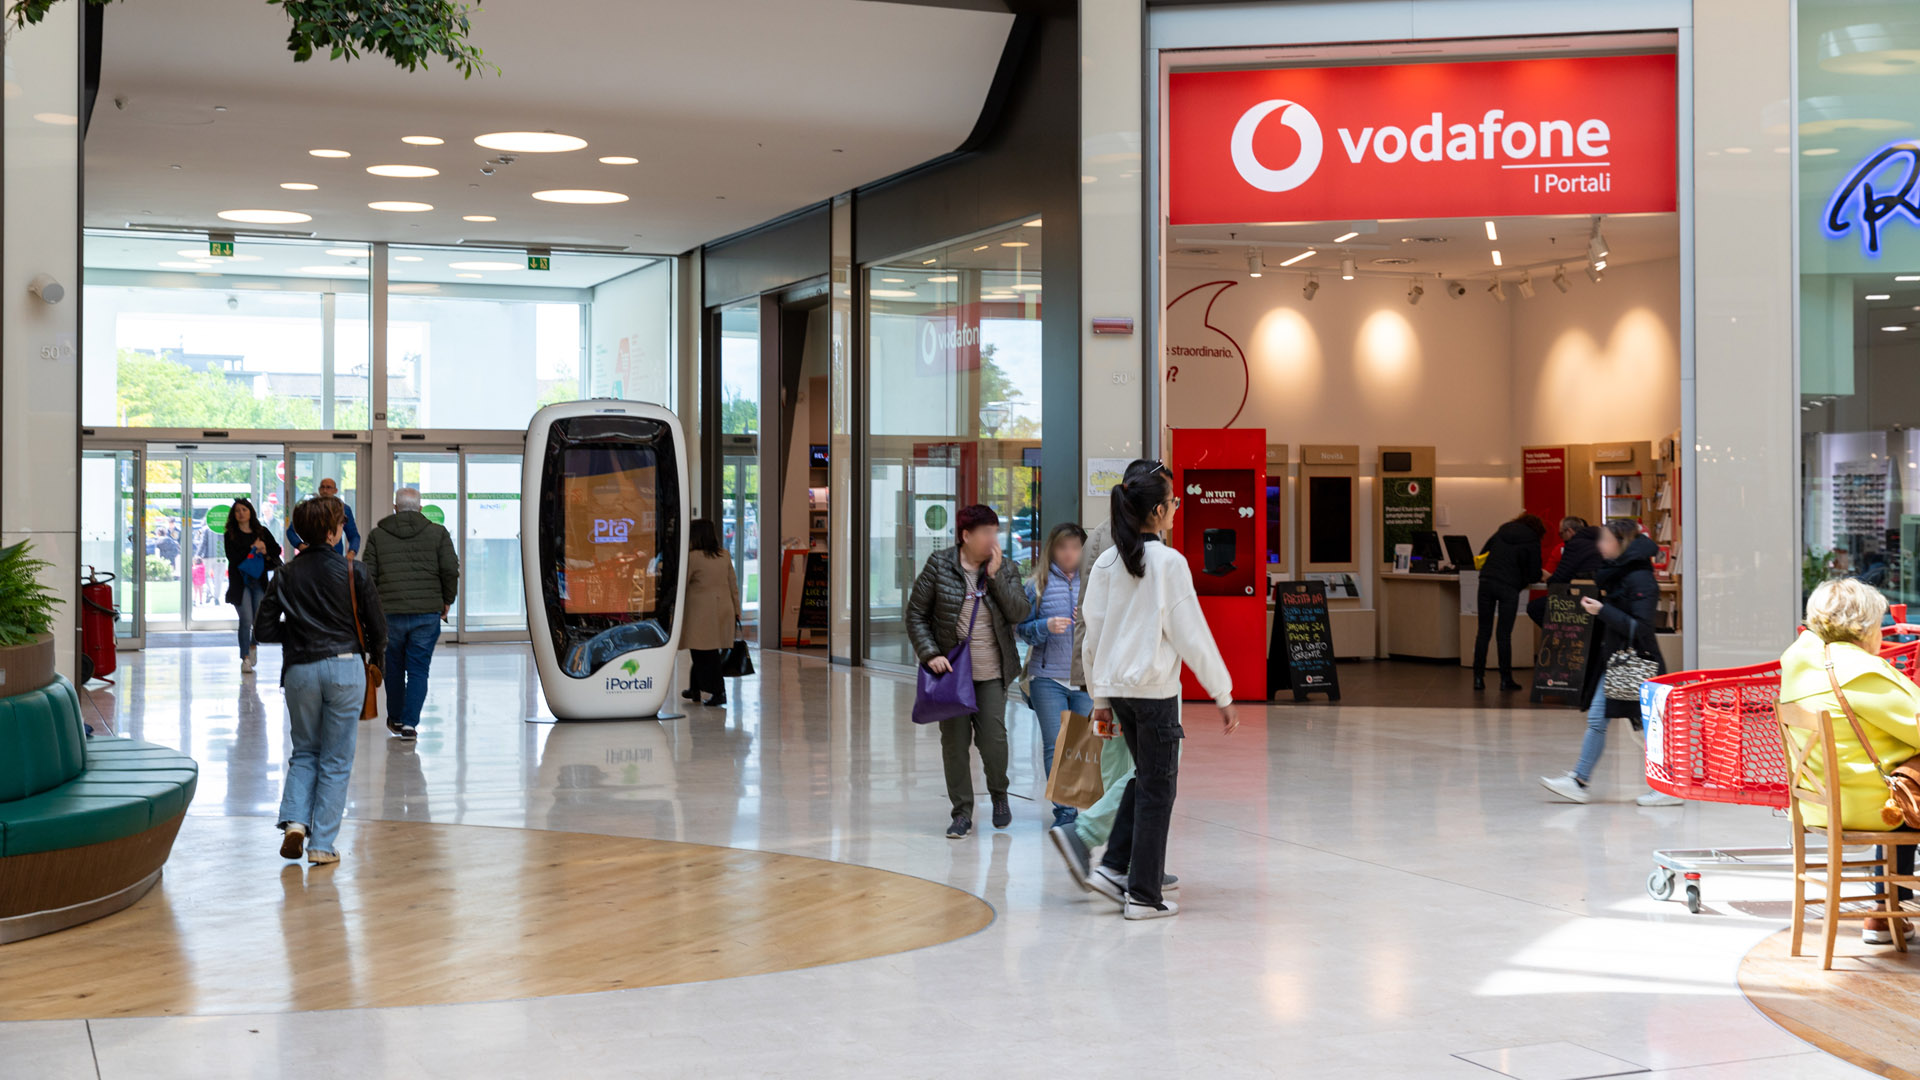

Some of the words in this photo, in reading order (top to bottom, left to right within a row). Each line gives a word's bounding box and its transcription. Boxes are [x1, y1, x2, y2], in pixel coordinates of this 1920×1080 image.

[1338, 109, 1611, 164] vodafone
[1533, 174, 1539, 194] I
[1544, 172, 1611, 194] Portali
[1828, 143, 1920, 252] R
[938, 322, 980, 351] vodafon
[1171, 345, 1234, 358] straordinario.
[1205, 490, 1214, 498] IN
[1214, 490, 1236, 498] TUTTI
